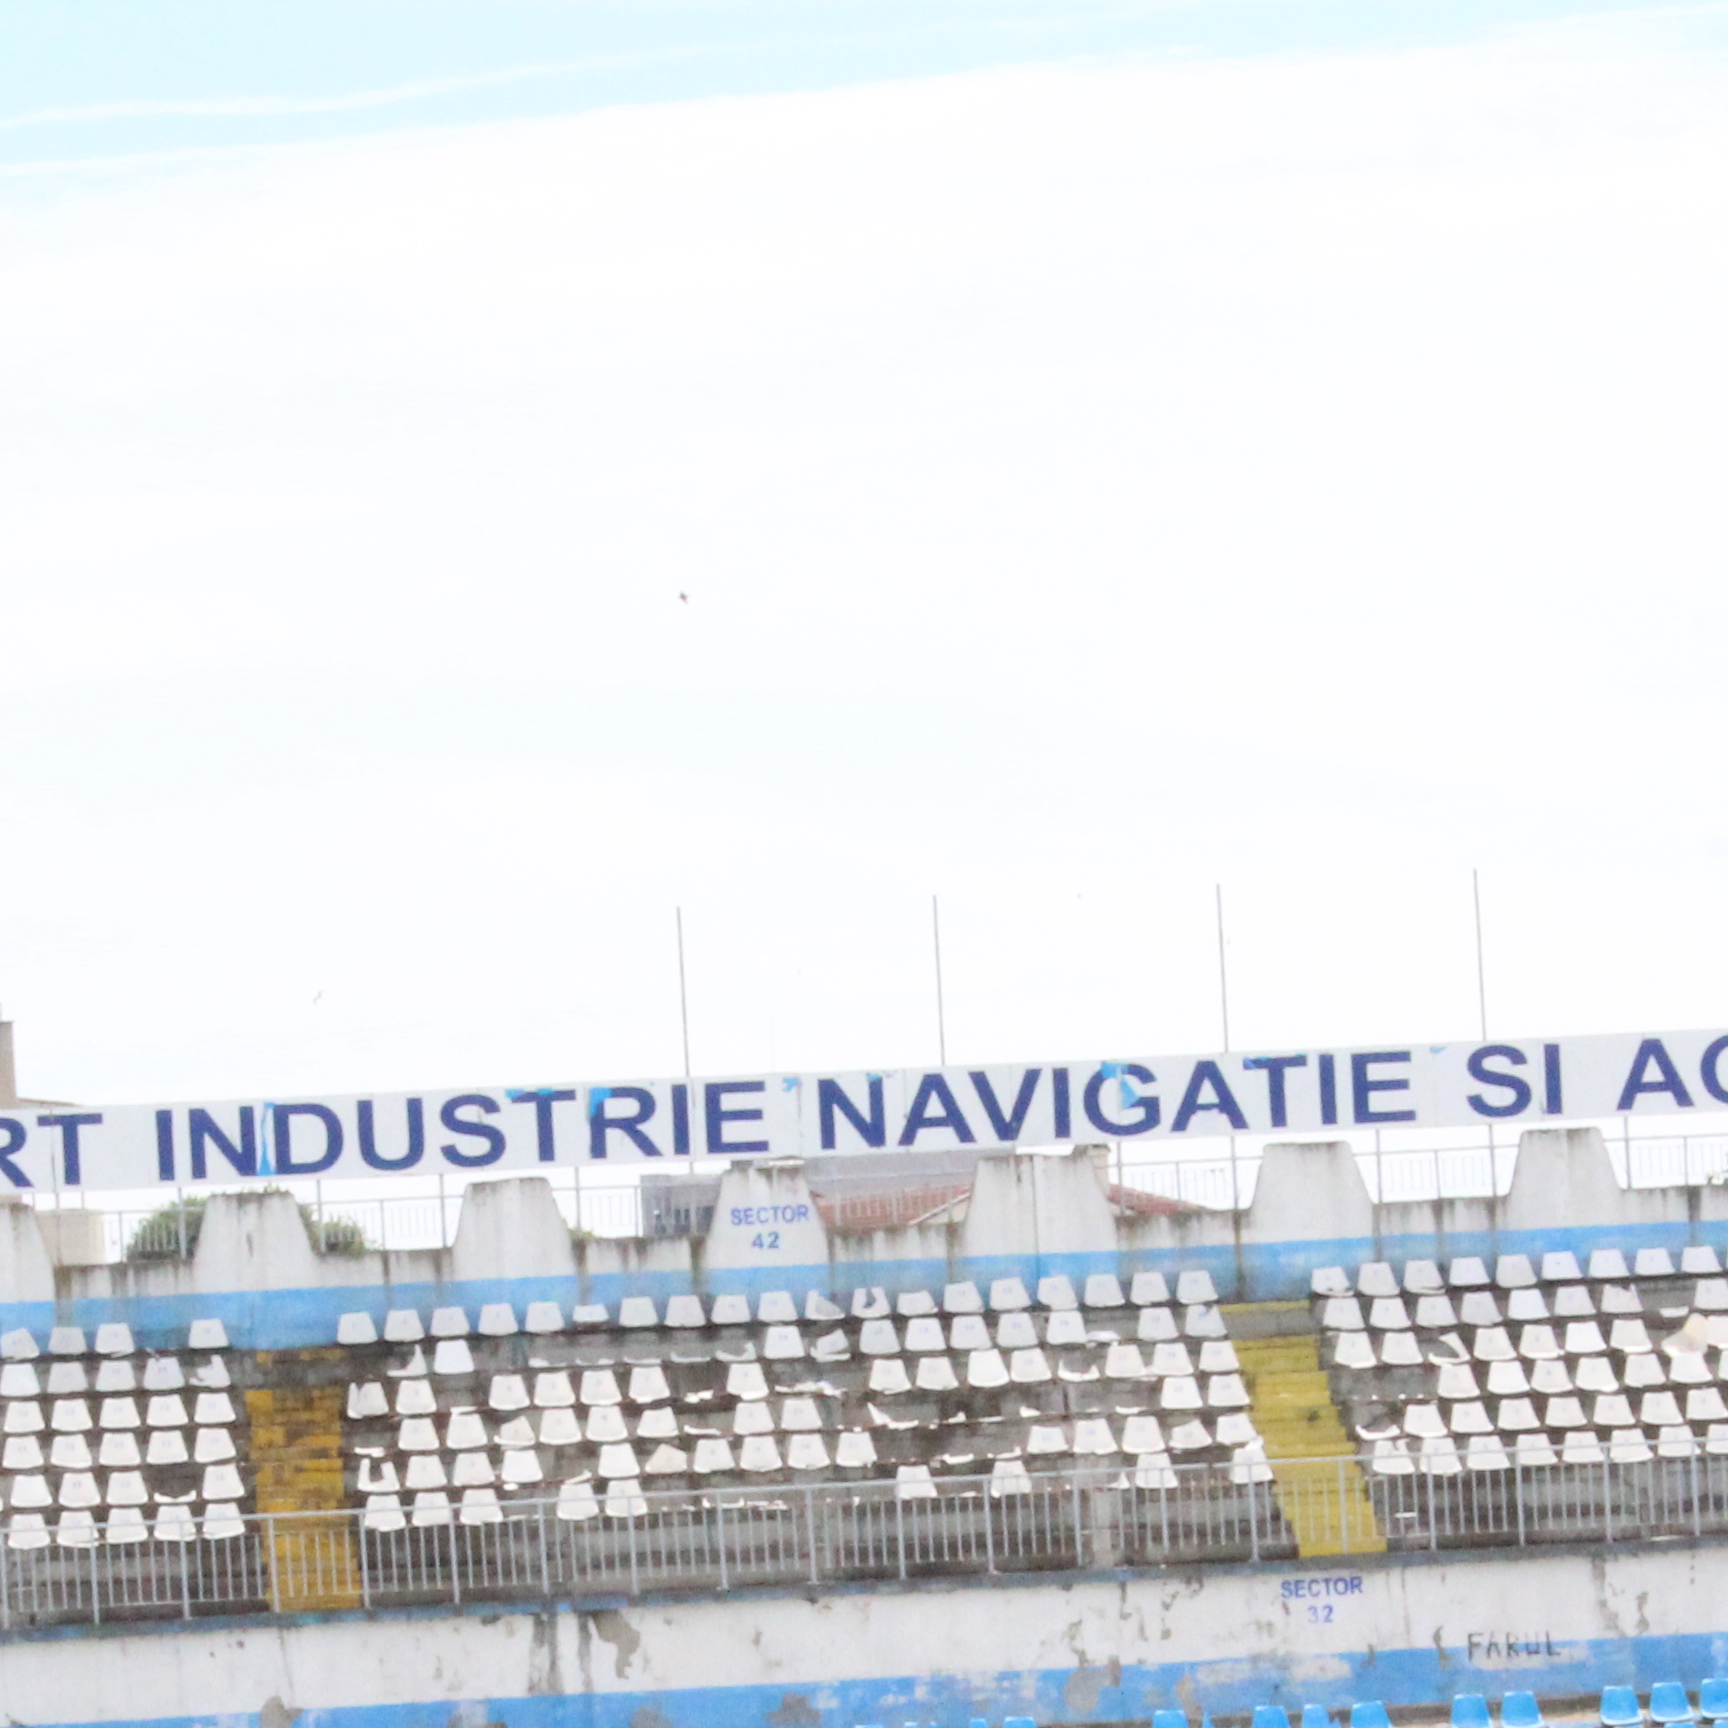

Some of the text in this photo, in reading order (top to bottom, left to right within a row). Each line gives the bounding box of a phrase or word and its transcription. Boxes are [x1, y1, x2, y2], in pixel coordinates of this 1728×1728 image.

[155, 1086, 769, 1183] INDUSTRIE
[818, 1050, 1415, 1150] NAVIGATIE
[1466, 1044, 1562, 1120] SI
[730, 1204, 810, 1226] SECTOR
[751, 1231, 780, 1250] 42
[1280, 1576, 1364, 1599] SECTOR
[1307, 1604, 1335, 1624] 32
[1466, 1629, 1563, 1662] FARUL
